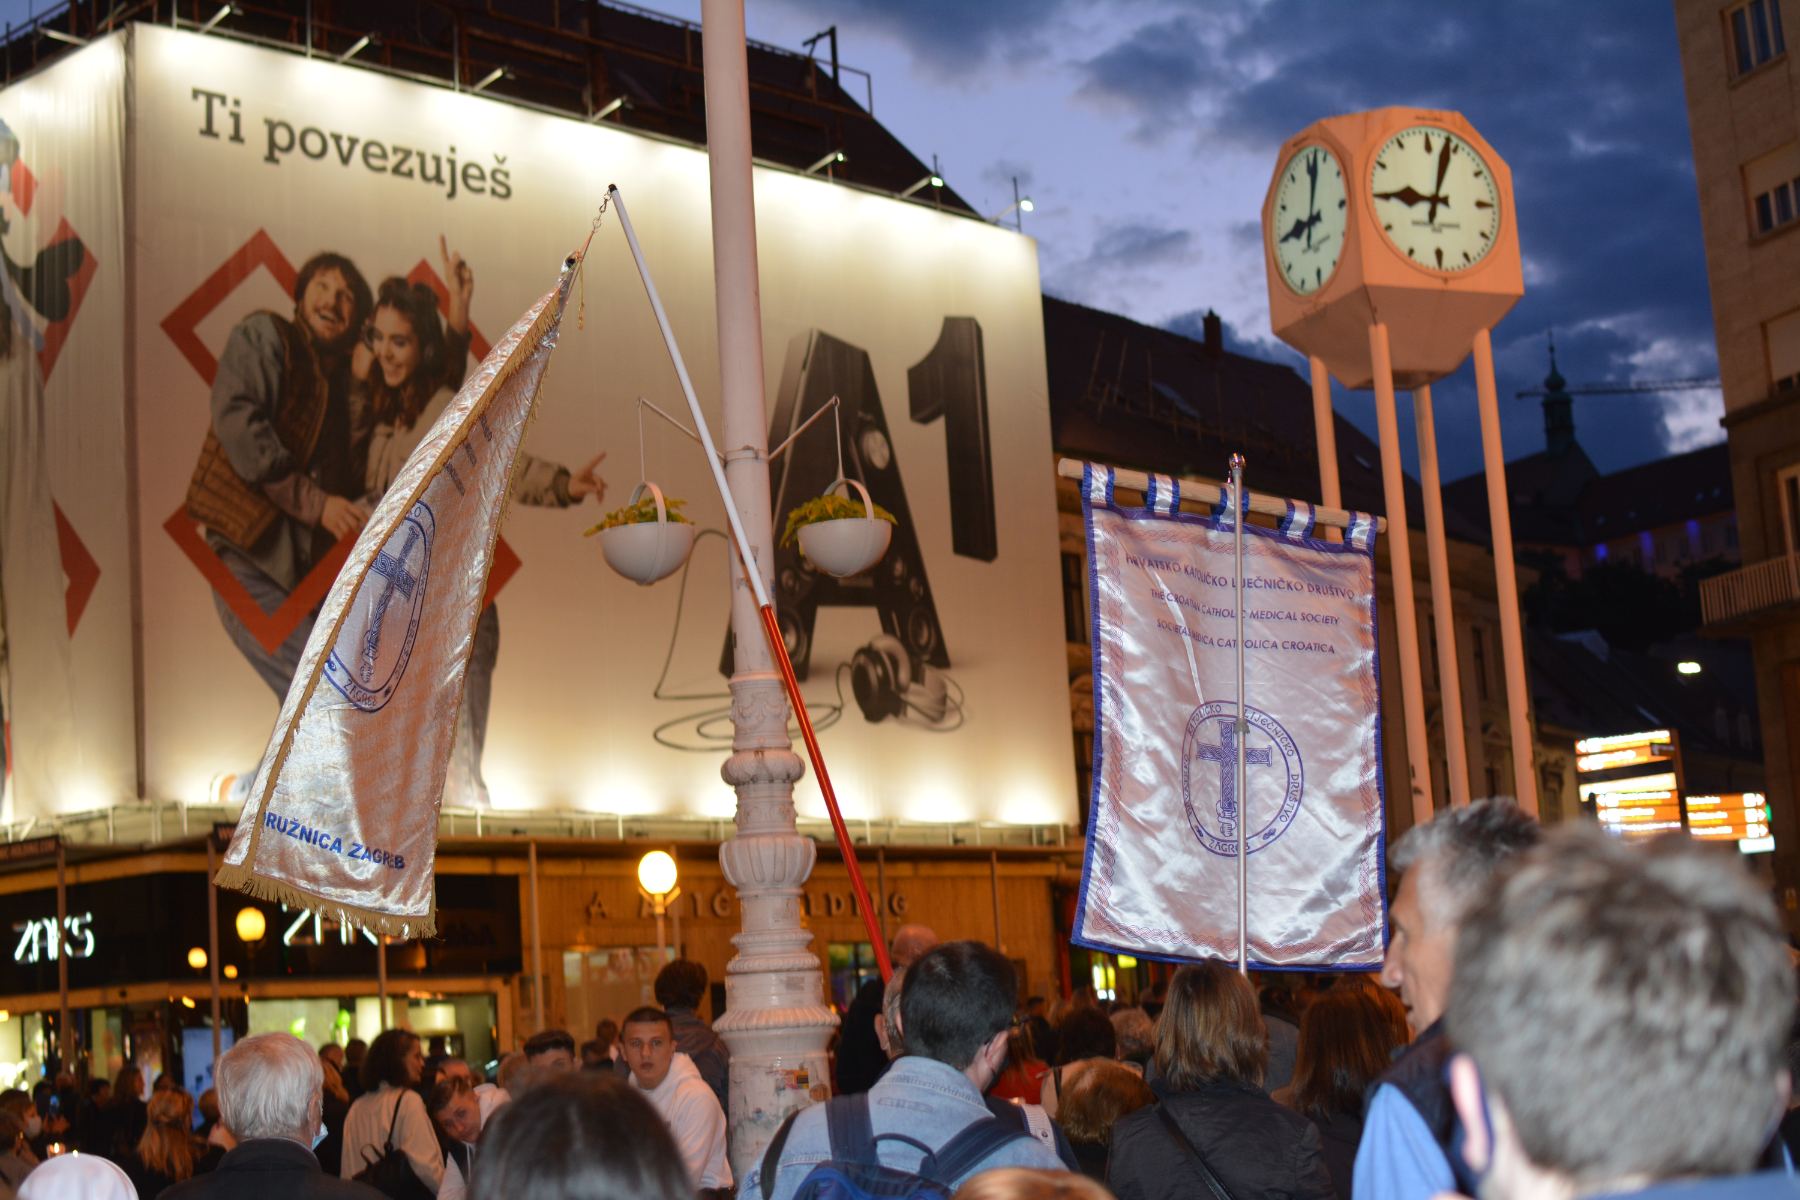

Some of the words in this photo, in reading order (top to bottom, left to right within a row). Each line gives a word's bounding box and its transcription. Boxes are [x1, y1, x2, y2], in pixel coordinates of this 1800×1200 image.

[191, 87, 245, 144] Ti
[263, 116, 512, 200] povezuješ
[719, 316, 998, 682] A1
[1231, 576, 1303, 592] LJEČNIČKO
[1307, 583, 1354, 600] DRUŠTVO
[1151, 588, 1165, 600] THE
[1201, 604, 1246, 619] CATHOLC
[1249, 610, 1297, 621] MEDICAL
[1301, 612, 1340, 625] SOCIETY
[1217, 638, 1278, 650] CATOLICA
[1281, 641, 1335, 655] CROATICA
[347, 842, 406, 870] ZAGREB
